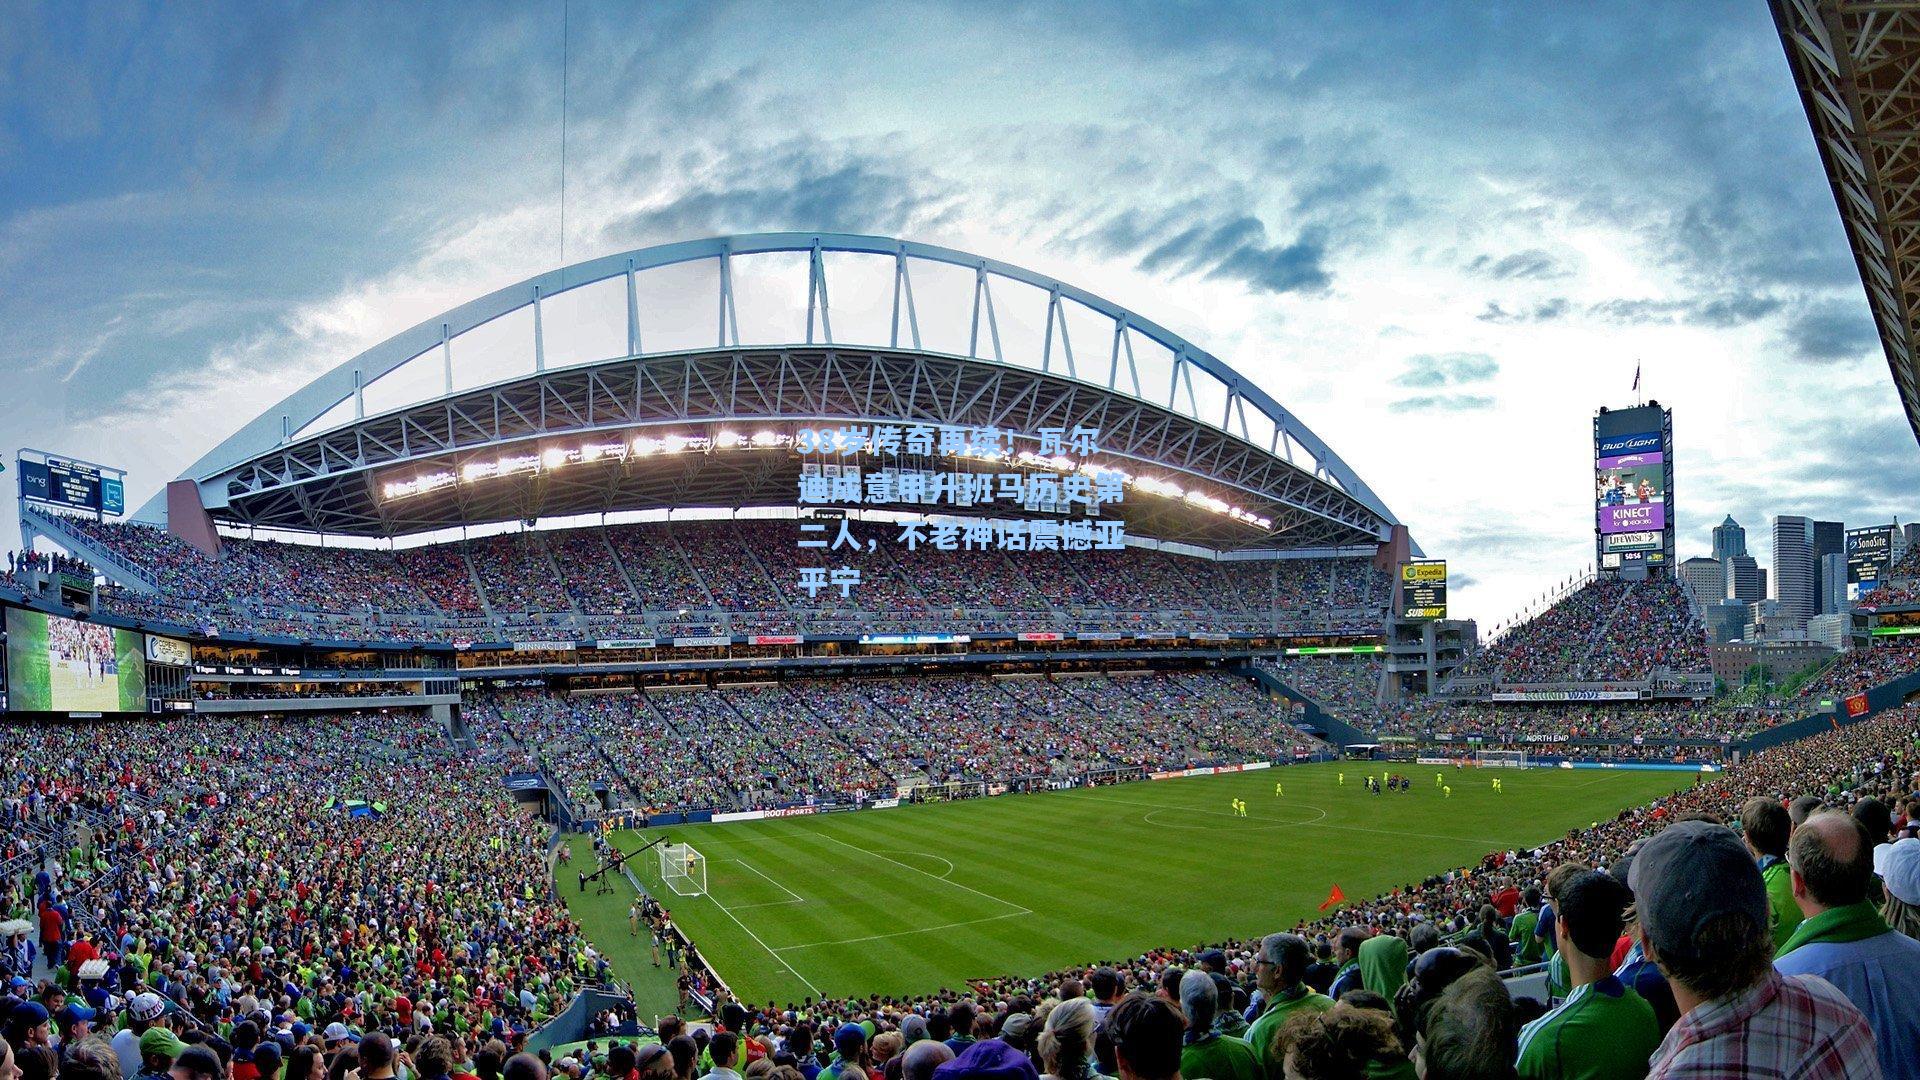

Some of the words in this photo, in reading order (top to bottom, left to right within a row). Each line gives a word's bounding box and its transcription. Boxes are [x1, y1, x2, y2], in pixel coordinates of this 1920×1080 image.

[1602, 442, 1624, 450] BUD
[1629, 438, 1658, 447] LIGHT
[26, 474, 46, 487] bing
[1613, 507, 1652, 519] KINECT
[1858, 536, 1886, 549] SonoSite
[1417, 569, 1442, 577] Expedia
[1405, 608, 1444, 617] SUBWAY
[765, 810, 785, 818] ROOT
[787, 807, 813, 815] SPORTS
